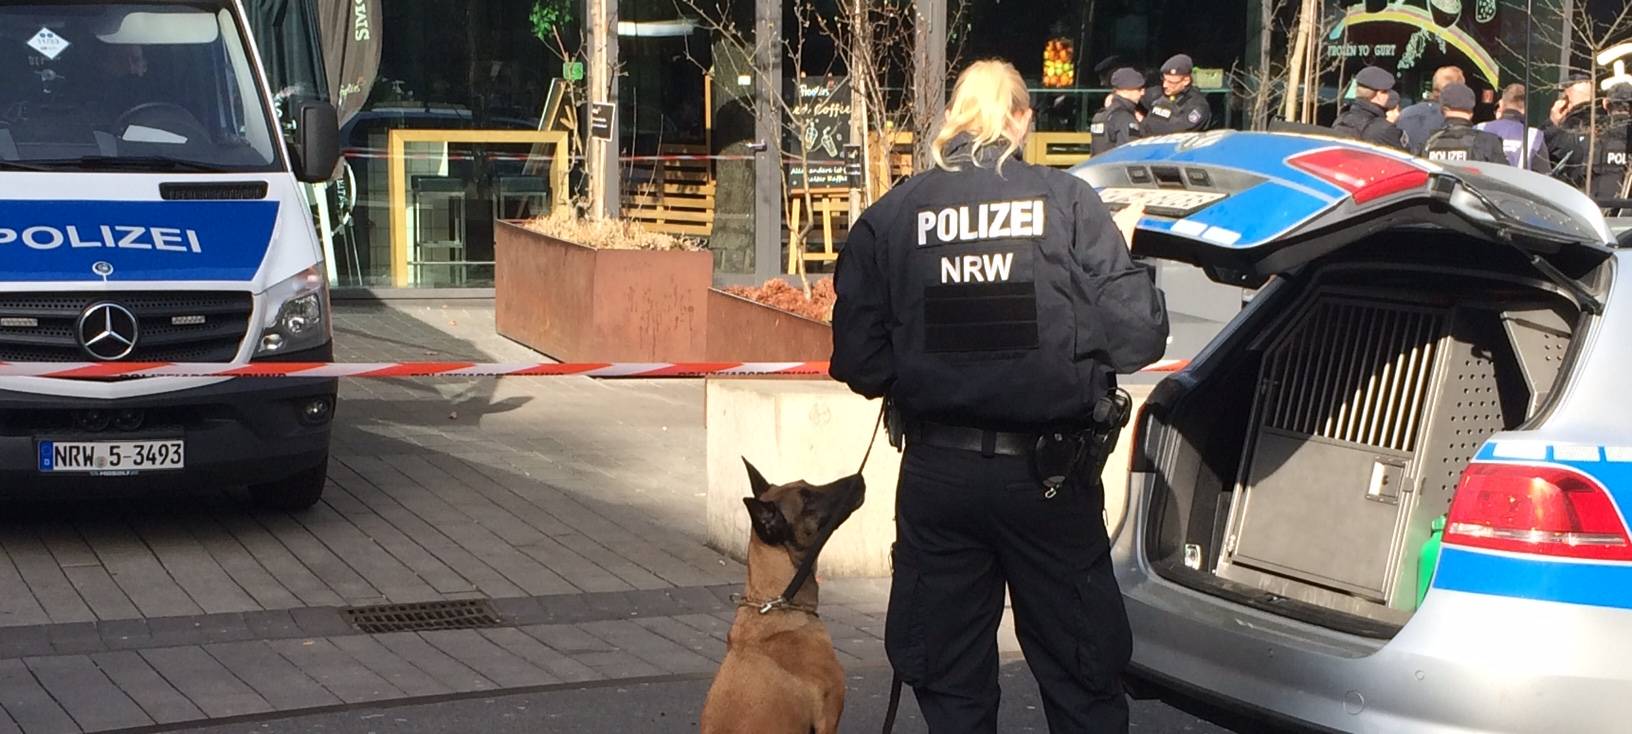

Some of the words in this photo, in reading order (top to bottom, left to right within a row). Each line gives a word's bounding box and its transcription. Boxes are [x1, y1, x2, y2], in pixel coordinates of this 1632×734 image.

[1607, 152, 1627, 165] POL
[917, 200, 1044, 246] POLIZEI
[941, 253, 1014, 284] NRW
[54, 445, 95, 467] NRW
[109, 443, 182, 467] 5-3493
